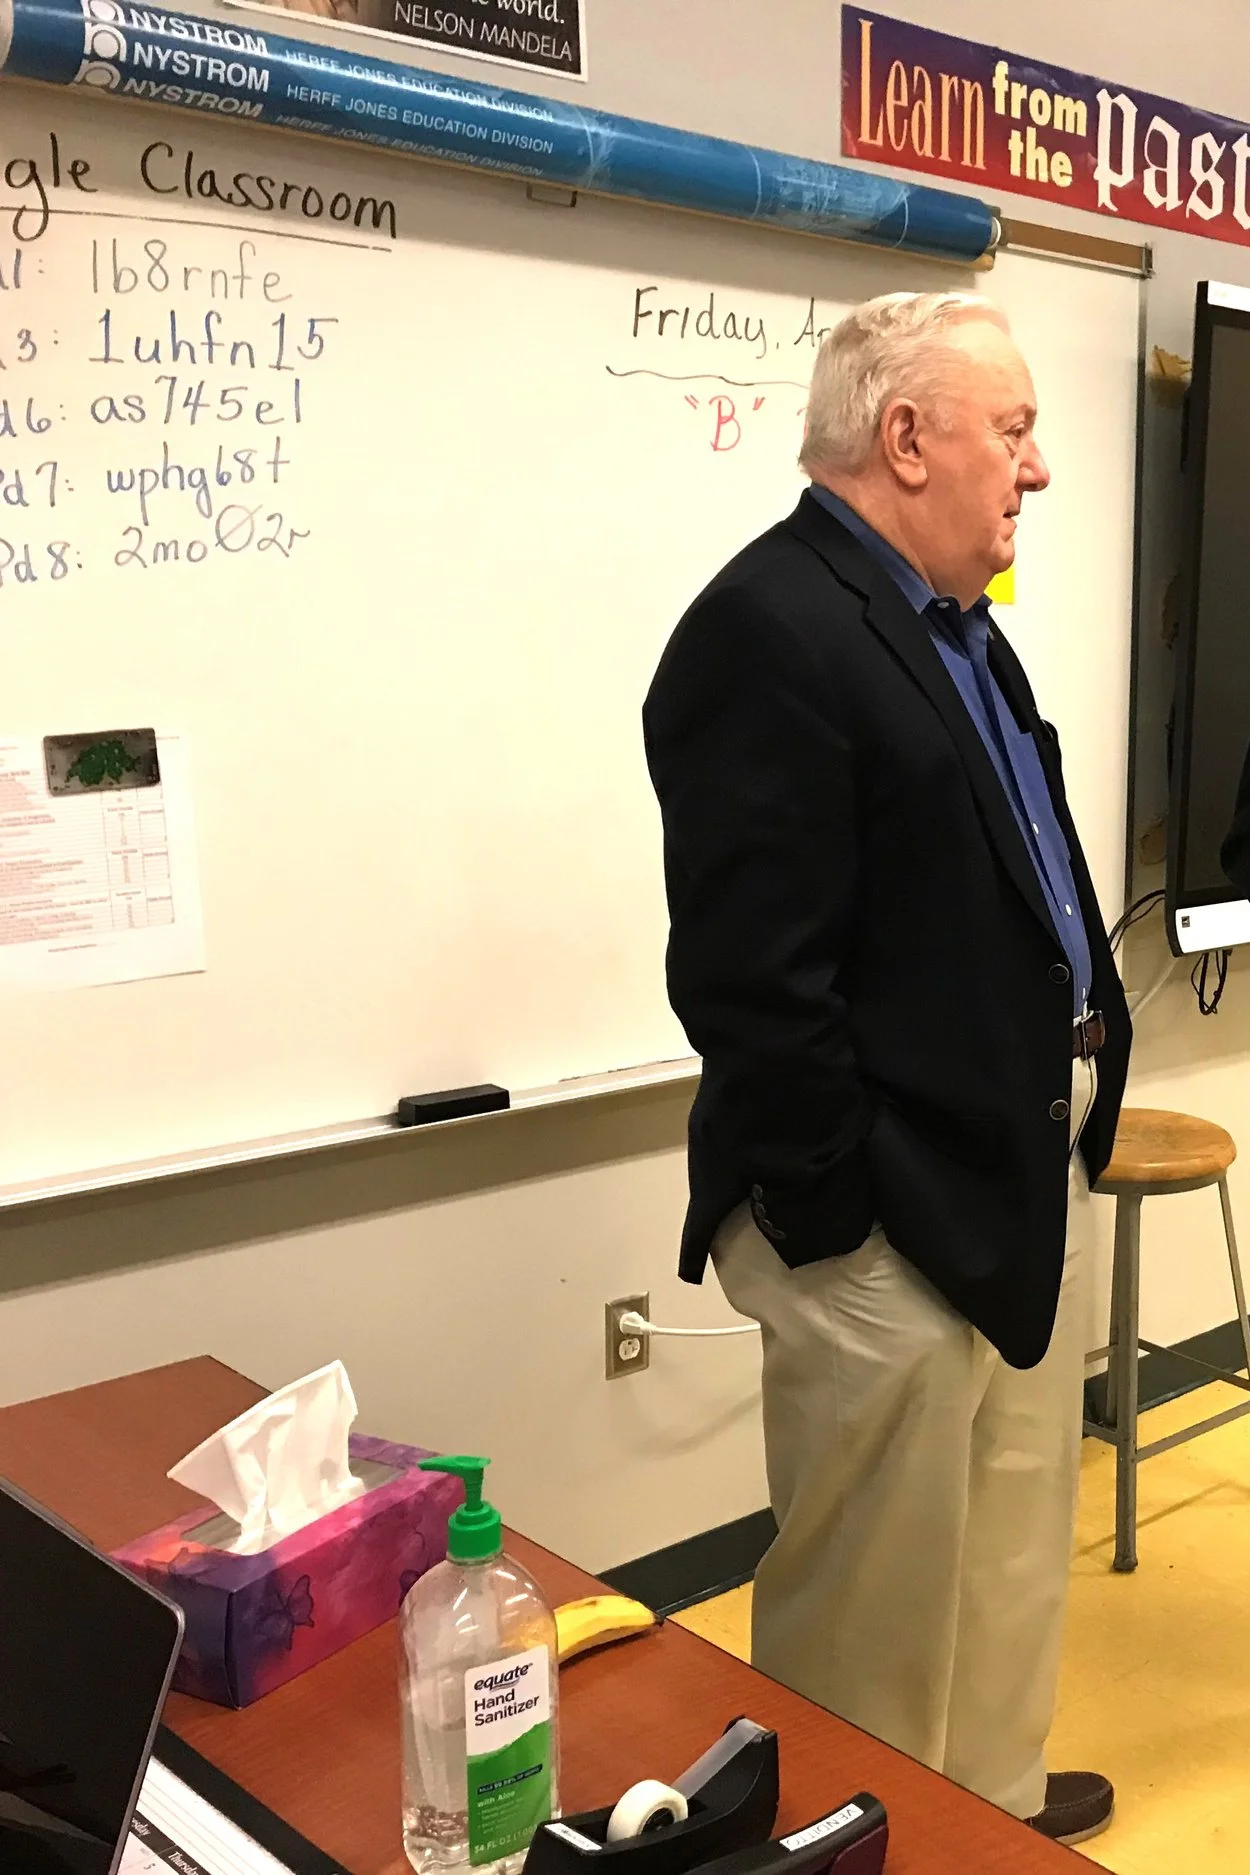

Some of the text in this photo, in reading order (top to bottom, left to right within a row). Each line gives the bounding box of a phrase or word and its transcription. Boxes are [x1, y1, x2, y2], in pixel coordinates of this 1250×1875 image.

[129, 8, 268, 58] NYSTROM
[393, 0, 573, 62] NELSON MANDELA
[123, 77, 265, 119] NYSTROM
[133, 42, 554, 154] NYSTROM HERFF JONES EDUCATION DIVISION
[857, 17, 988, 171] Learn
[993, 61, 1088, 137] from
[1008, 127, 1074, 188] the
[140, 141, 397, 239] Classroom
[474, 1664, 529, 1690] equate
[474, 1688, 516, 1713] Hand
[475, 1696, 540, 1727] Sanitizer
[477, 1791, 516, 1808] with Aloe
